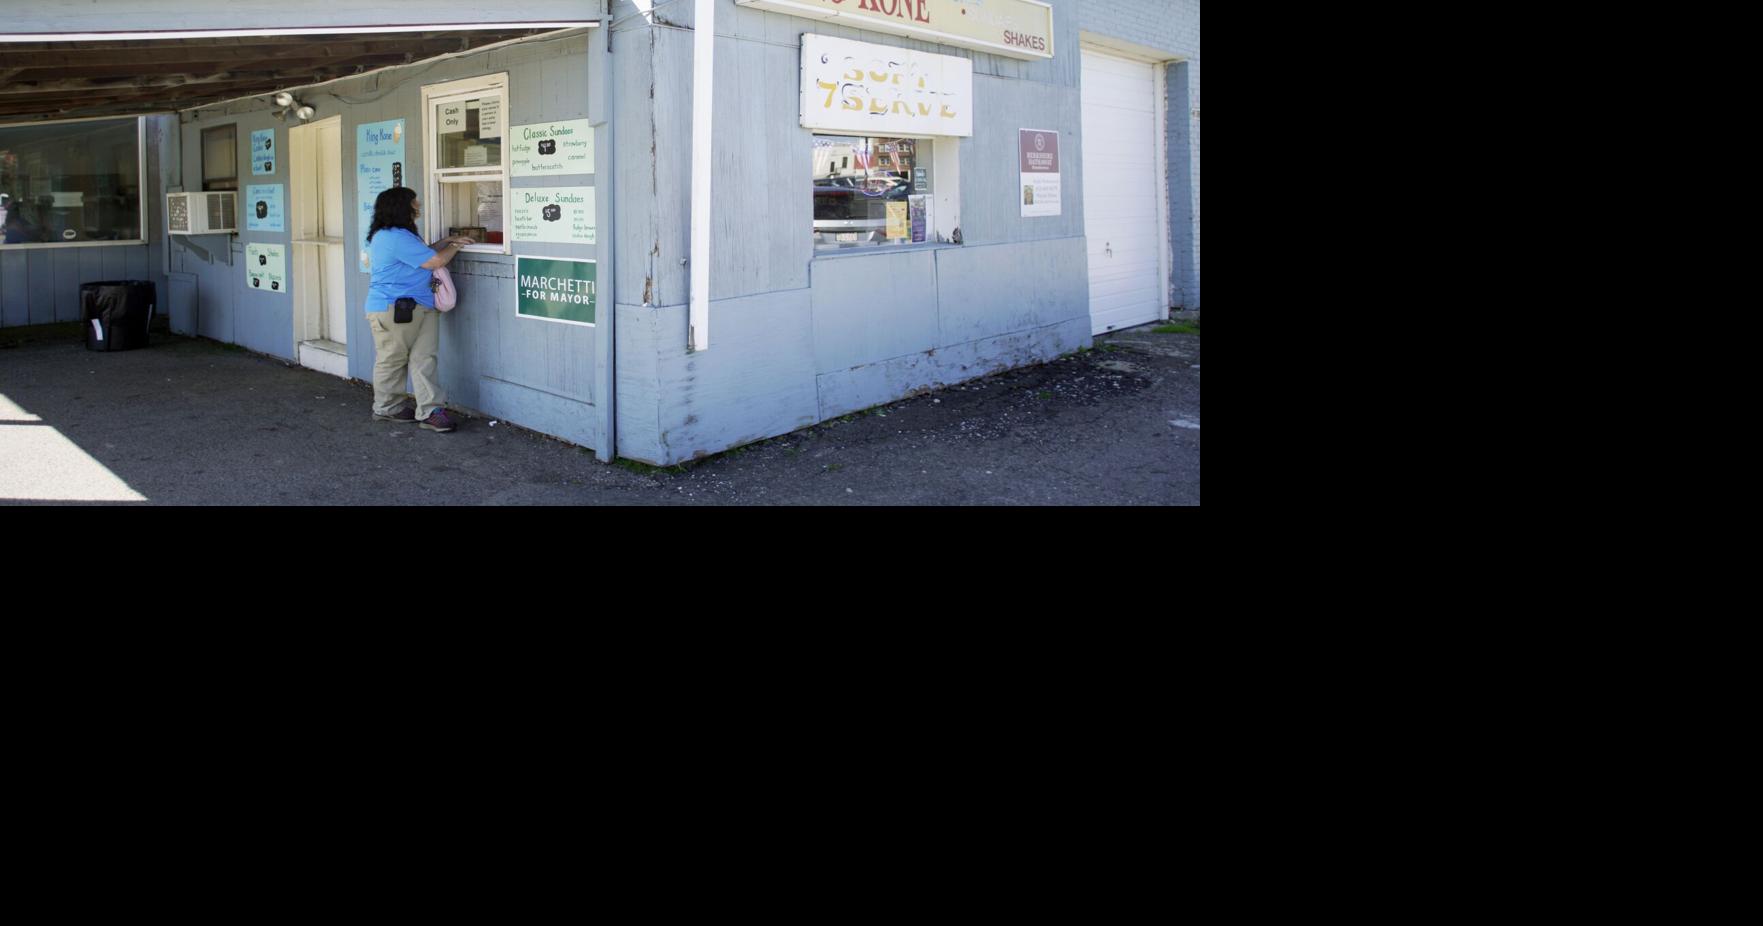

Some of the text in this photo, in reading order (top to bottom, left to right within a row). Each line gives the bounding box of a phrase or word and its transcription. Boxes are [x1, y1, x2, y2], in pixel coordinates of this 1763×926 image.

[1003, 29, 1045, 51] SHAKES
[444, 107, 459, 116] Cash
[445, 118, 459, 126] Only
[366, 128, 379, 145] King
[523, 127, 547, 140] Classic
[525, 192, 584, 203] Deluxe Sundaes
[520, 274, 595, 295] MARCHETTI
